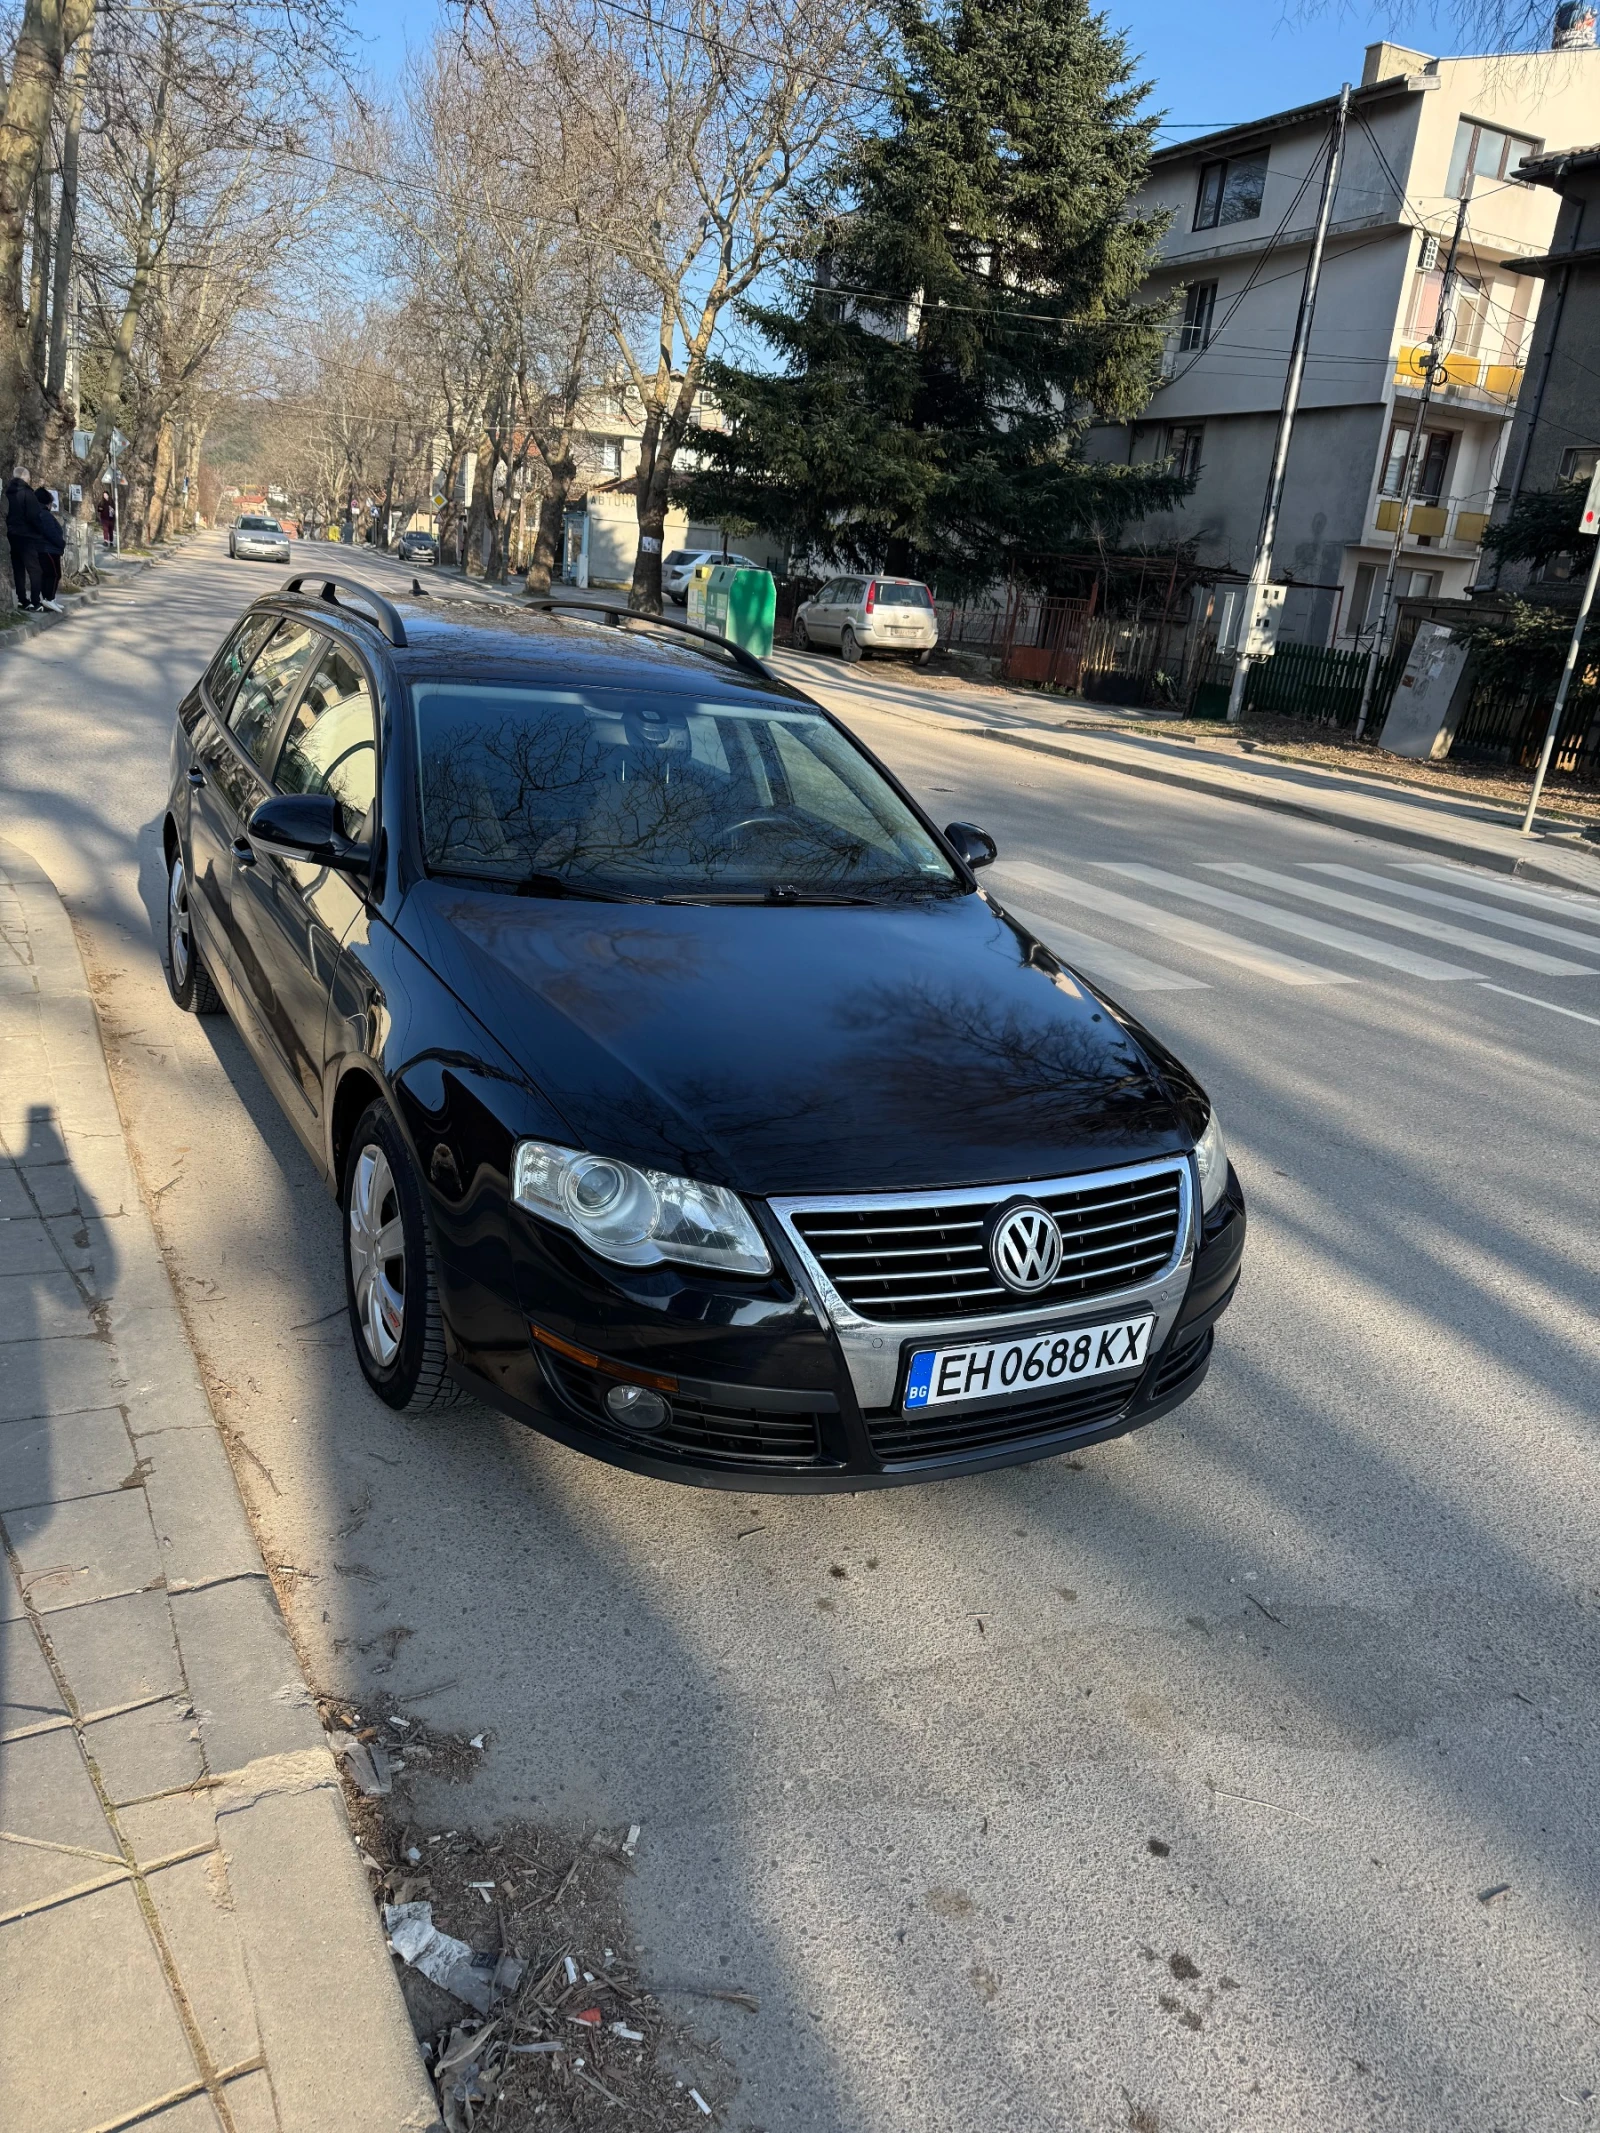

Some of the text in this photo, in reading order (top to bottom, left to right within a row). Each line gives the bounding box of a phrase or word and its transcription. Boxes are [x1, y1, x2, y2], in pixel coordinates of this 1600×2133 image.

[591, 495, 635, 507] АВТОЧА
[996, 1208, 1061, 1289] VW
[908, 1385, 928, 1400] BG
